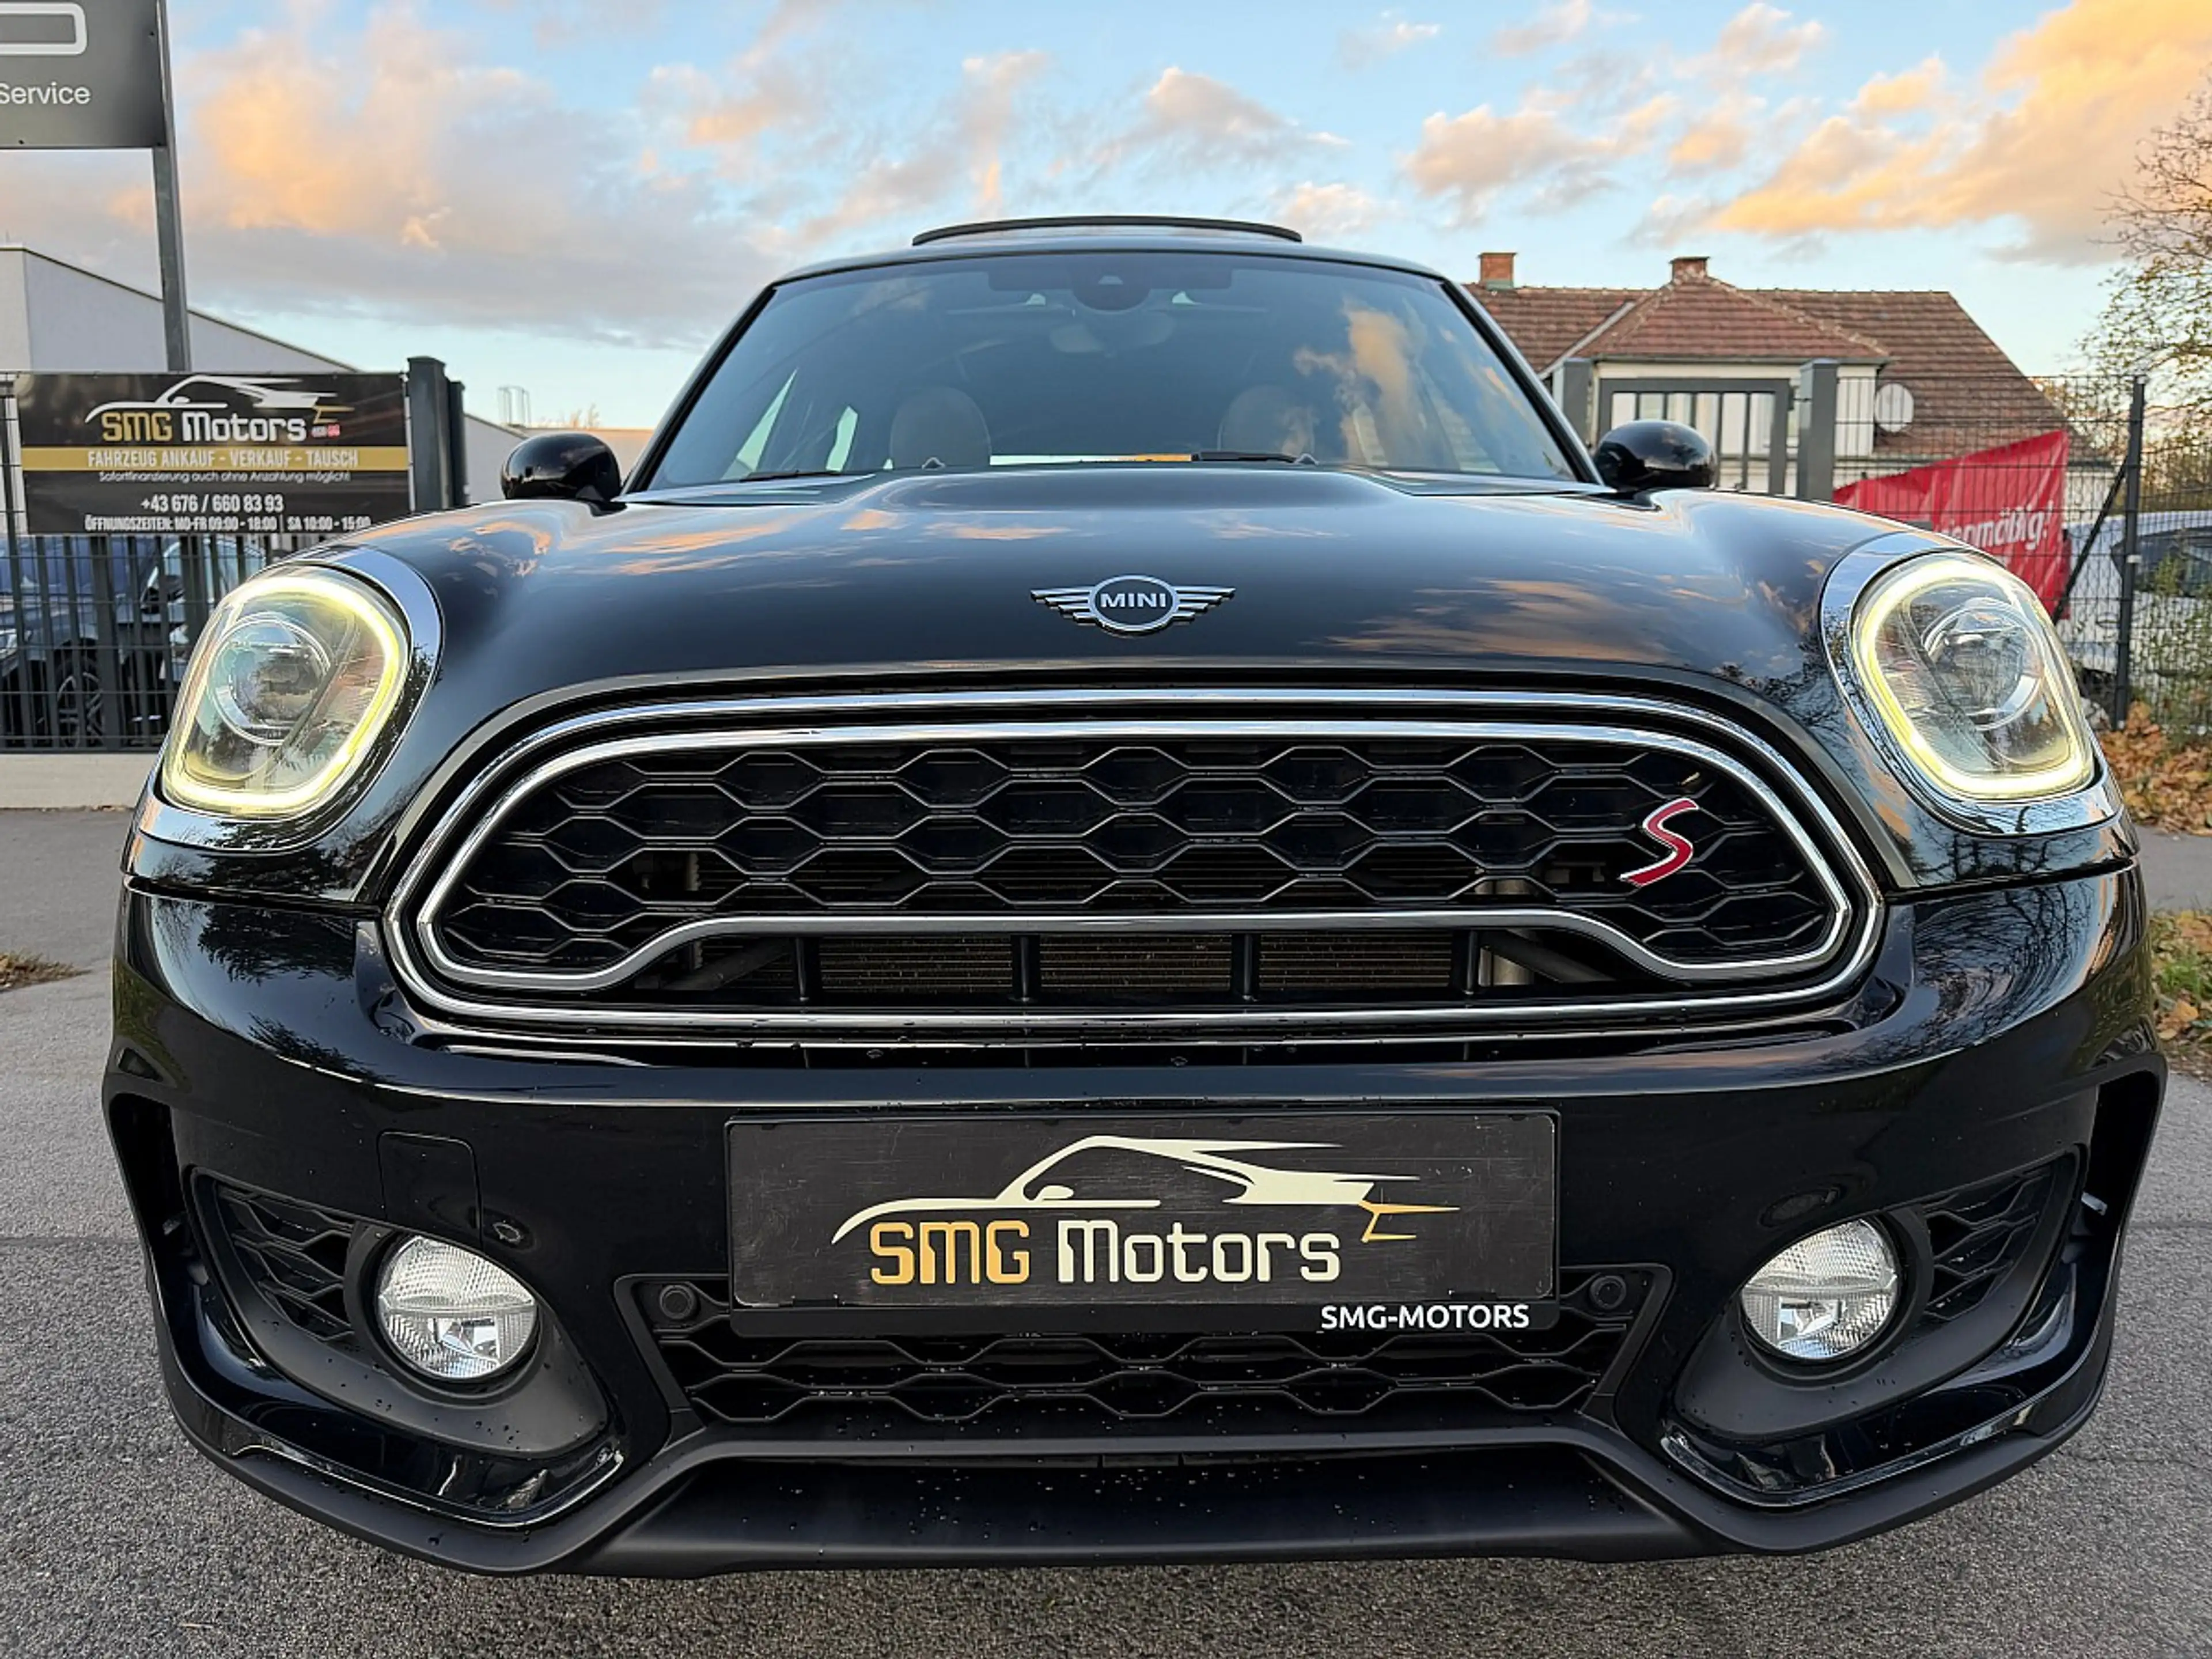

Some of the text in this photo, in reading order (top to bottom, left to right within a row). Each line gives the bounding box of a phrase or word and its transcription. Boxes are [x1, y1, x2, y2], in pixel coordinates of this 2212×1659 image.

[0, 82, 90, 104] Service
[101, 412, 172, 442] SMG
[182, 411, 306, 442] Motors
[88, 450, 157, 467] FAHRZEUG
[162, 450, 215, 467] ANKAUF
[230, 449, 291, 467] VERKAUF
[306, 449, 358, 467] TAUSCH
[192, 472, 218, 482] auch
[221, 471, 247, 482] ohne
[249, 471, 304, 483] Anzahlung
[141, 494, 169, 513] +43
[172, 494, 198, 513] 676
[212, 494, 240, 513] 660
[244, 494, 262, 513] 83
[264, 494, 284, 513] 93
[175, 516, 207, 531] MO-FR
[248, 516, 277, 531] 18:00
[287, 516, 302, 531] SA
[304, 516, 333, 531] 10:00
[1100, 593, 1166, 608] MINI
[1618, 797, 1699, 886] S
[870, 1219, 1340, 1285] SMG Motors
[1321, 1304, 1530, 1330] SMG-MOTORS
